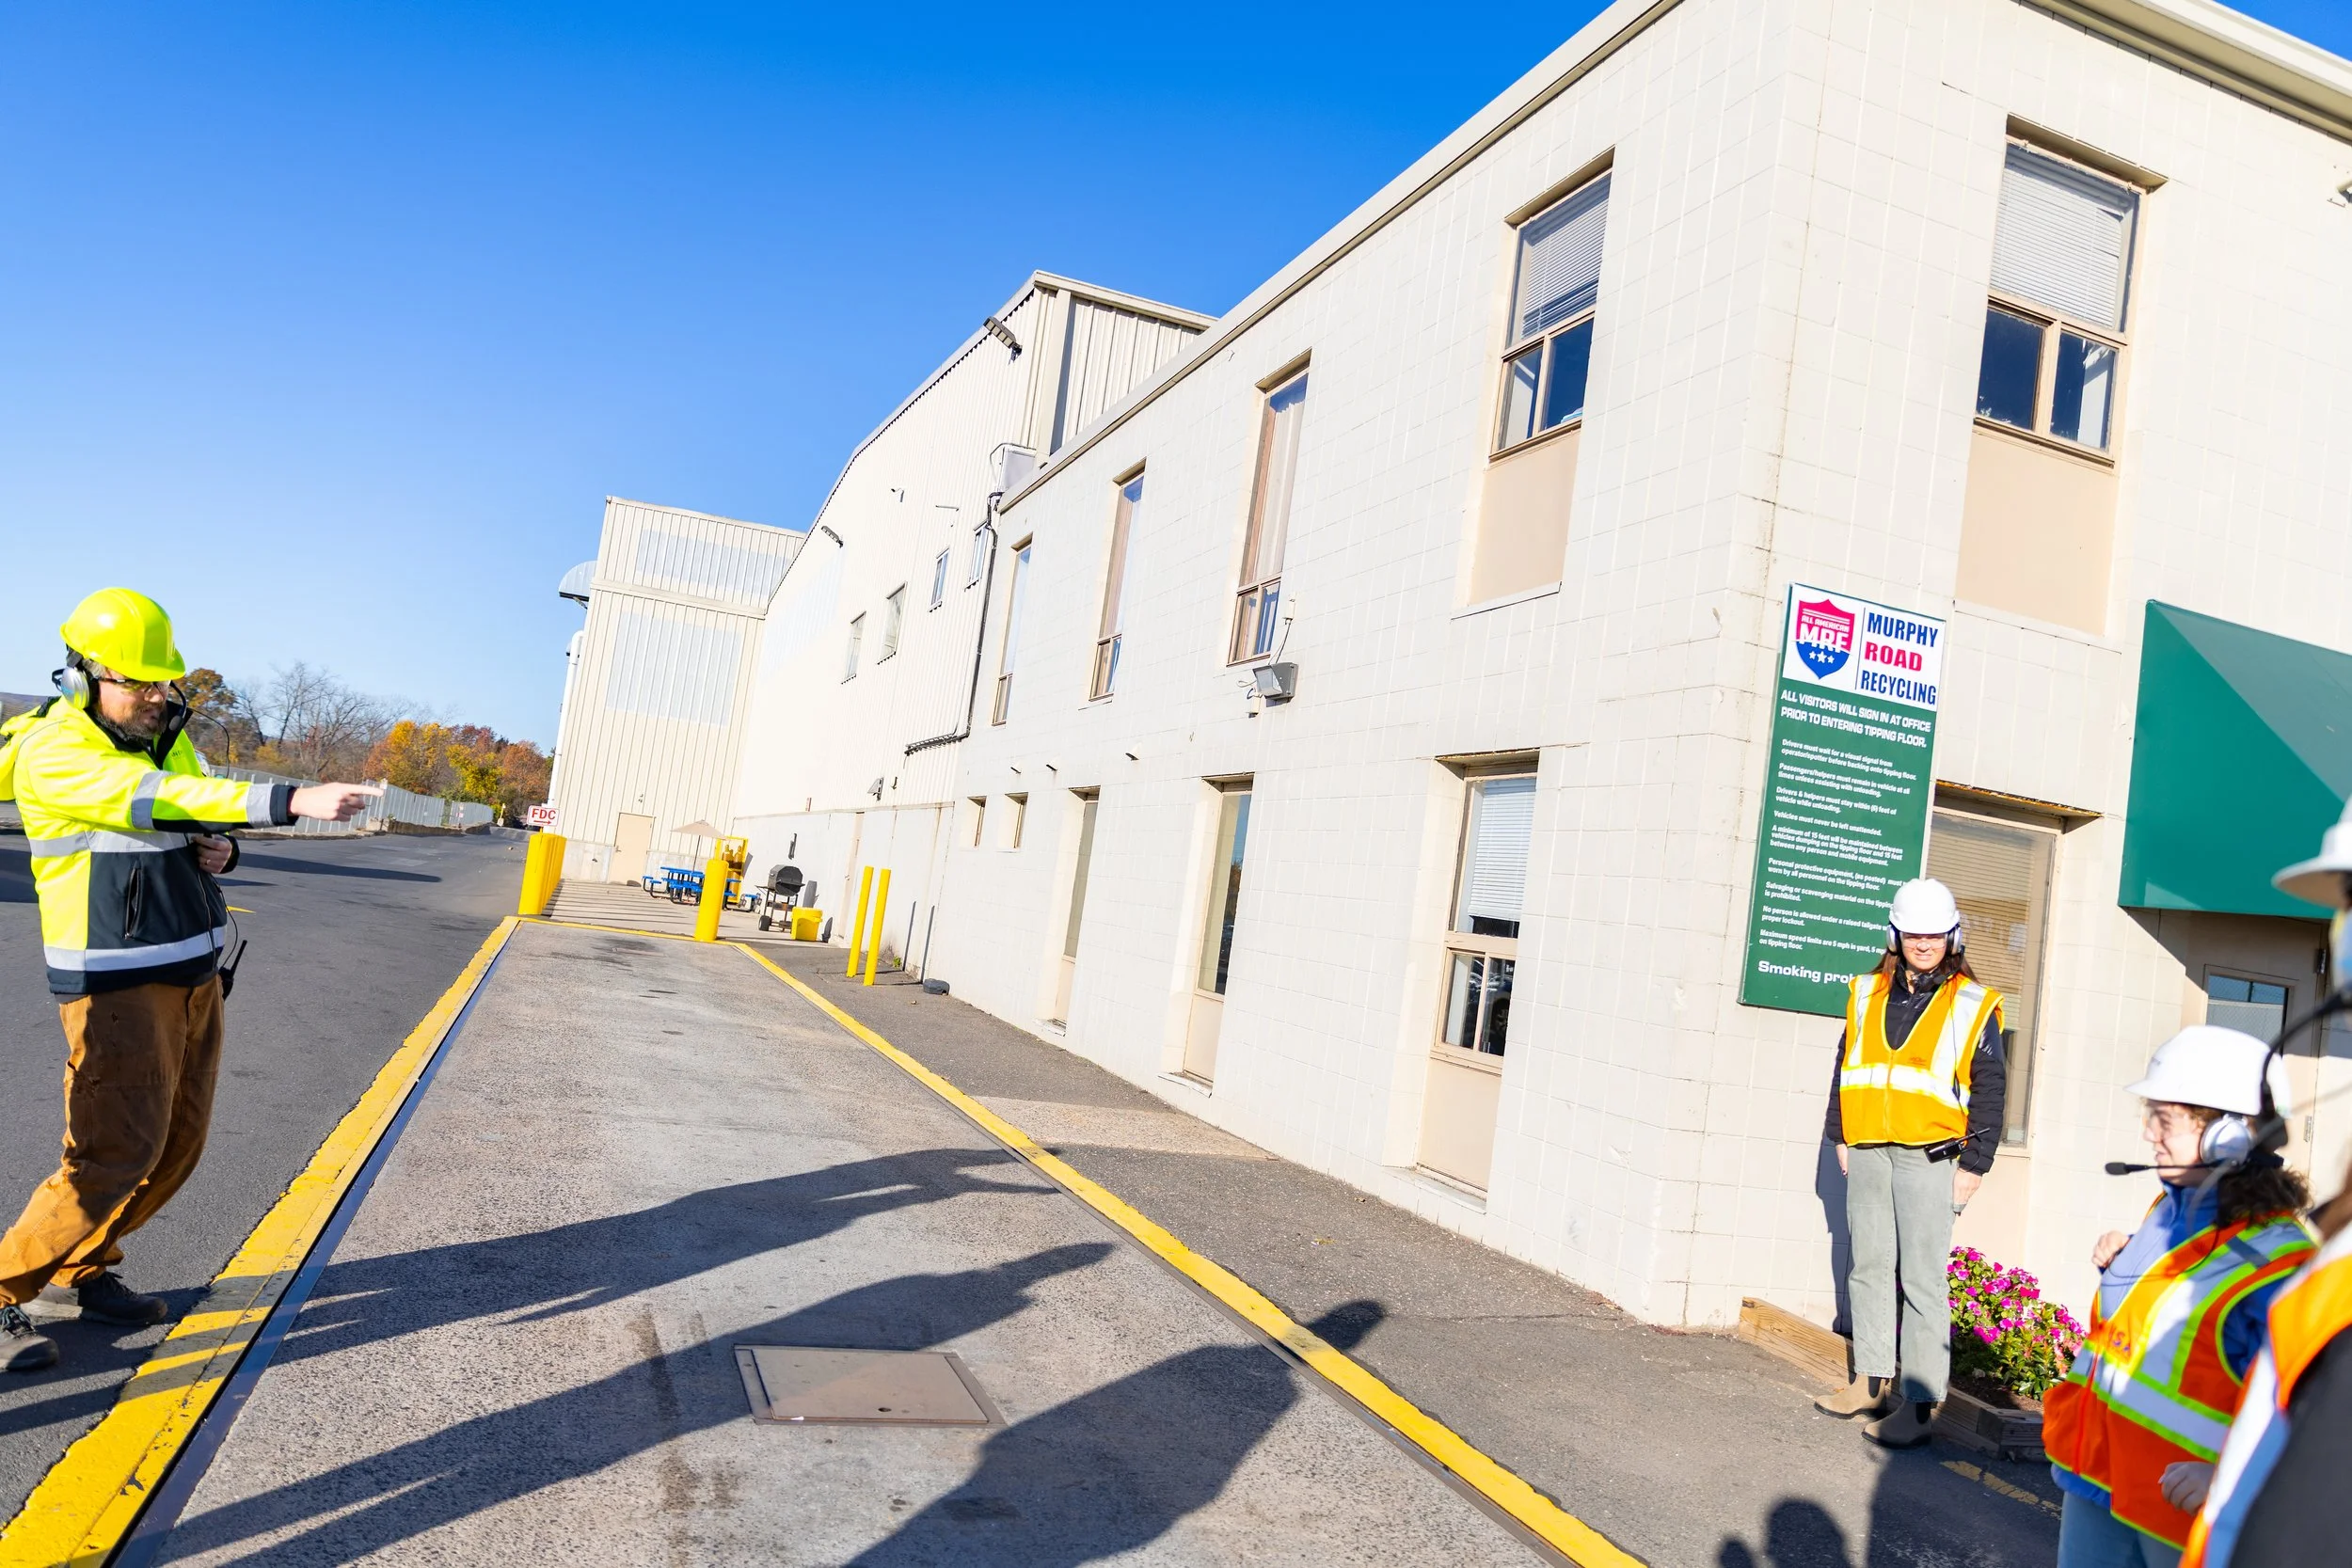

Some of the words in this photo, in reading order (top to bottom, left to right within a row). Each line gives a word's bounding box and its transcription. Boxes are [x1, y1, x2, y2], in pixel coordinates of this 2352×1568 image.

[1801, 615, 1814, 625] ALL
[1815, 618, 1851, 633] AMERICAN
[1867, 612, 1938, 647] MURPHY
[1799, 623, 1850, 654] MRF
[1865, 641, 1922, 672] ROAD
[1861, 670, 1936, 705] RECYCLING
[1781, 689, 1798, 703] ALL
[1799, 693, 1838, 712] VISITORS
[1838, 703, 1858, 717] WILL
[1858, 707, 1880, 721] SIGN
[1879, 712, 1889, 723] IN
[1889, 715, 1901, 725] AT
[1900, 717, 1931, 733] OFFICE
[1781, 706, 1807, 721] PRIOR
[1808, 712, 1820, 724] TO
[1820, 716, 1864, 734] ENTERING
[1864, 725, 1897, 741] TIPPING
[1897, 732, 1927, 748] FLOOR.
[1782, 738, 1804, 749] Drivers
[1804, 744, 1819, 752] must
[1845, 752, 1862, 761] visual
[1862, 756, 1879, 765] signal
[1879, 759, 1893, 768] from
[1828, 756, 1847, 767] before
[1847, 760, 1869, 772] backing
[1883, 768, 1902, 779] tipping
[1902, 771, 1916, 781] floor.
[1776, 786, 1798, 797] Drivers
[1804, 792, 1825, 801] helpers
[1840, 800, 1853, 808] stay
[1778, 771, 1795, 780] times
[1795, 775, 1815, 784] unless
[1814, 779, 1840, 790] assisting
[1853, 786, 1882, 798] unloading.
[1851, 778, 1871, 786] remain
[1877, 784, 1897, 792] vehicle
[532, 809, 556, 819] FDC
[1775, 796, 1797, 804] vehicle
[1812, 802, 1841, 814] unloading.
[1774, 810, 1798, 821] Vehicles
[1814, 818, 1831, 827] never
[1849, 826, 1882, 836] unattended.
[1770, 839, 1795, 849] between
[1795, 845, 1806, 853] any
[1806, 847, 1828, 855] person
[1839, 852, 1858, 861] mobile
[1858, 856, 1888, 866] equipment.
[1772, 832, 1795, 841] vehicles
[1795, 836, 1820, 847] dumping
[1839, 843, 1859, 854] tipping
[1858, 847, 1873, 855] floor
[1872, 848, 1884, 858] and
[1884, 850, 1891, 859] 15
[1891, 852, 1902, 861] feet
[1777, 827, 1804, 836] minimum
[1819, 832, 1831, 841] feet
[1848, 840, 1880, 850] maintained
[1879, 844, 1903, 854] between
[1769, 858, 1795, 869] Personal
[1794, 863, 1823, 873] protective
[1823, 868, 1854, 880] equipment,
[1854, 873, 1865, 881] (as
[1864, 875, 1886, 885] posted)
[1887, 879, 1903, 889] must
[1783, 868, 1791, 877] by
[1798, 872, 1828, 881] personnel
[1846, 879, 1866, 890] tipping
[1866, 882, 1880, 891] floor.
[1766, 881, 1794, 895] Salvaging
[1801, 889, 1834, 900] scavenging
[1834, 894, 1857, 902] material
[1771, 892, 1801, 901] prohibited.
[1761, 914, 1782, 923] proper
[1782, 916, 1805, 927] lockout.
[1772, 908, 1793, 917] person
[1799, 911, 1821, 921] allowed
[1843, 919, 1862, 927] raised
[1861, 921, 1883, 930] tailgate
[1760, 929, 1788, 940] Maximum
[1806, 936, 1822, 944] limits
[1768, 939, 1788, 949] tipping
[1788, 942, 1803, 950] floor.
[1758, 960, 1821, 983] Smoking
